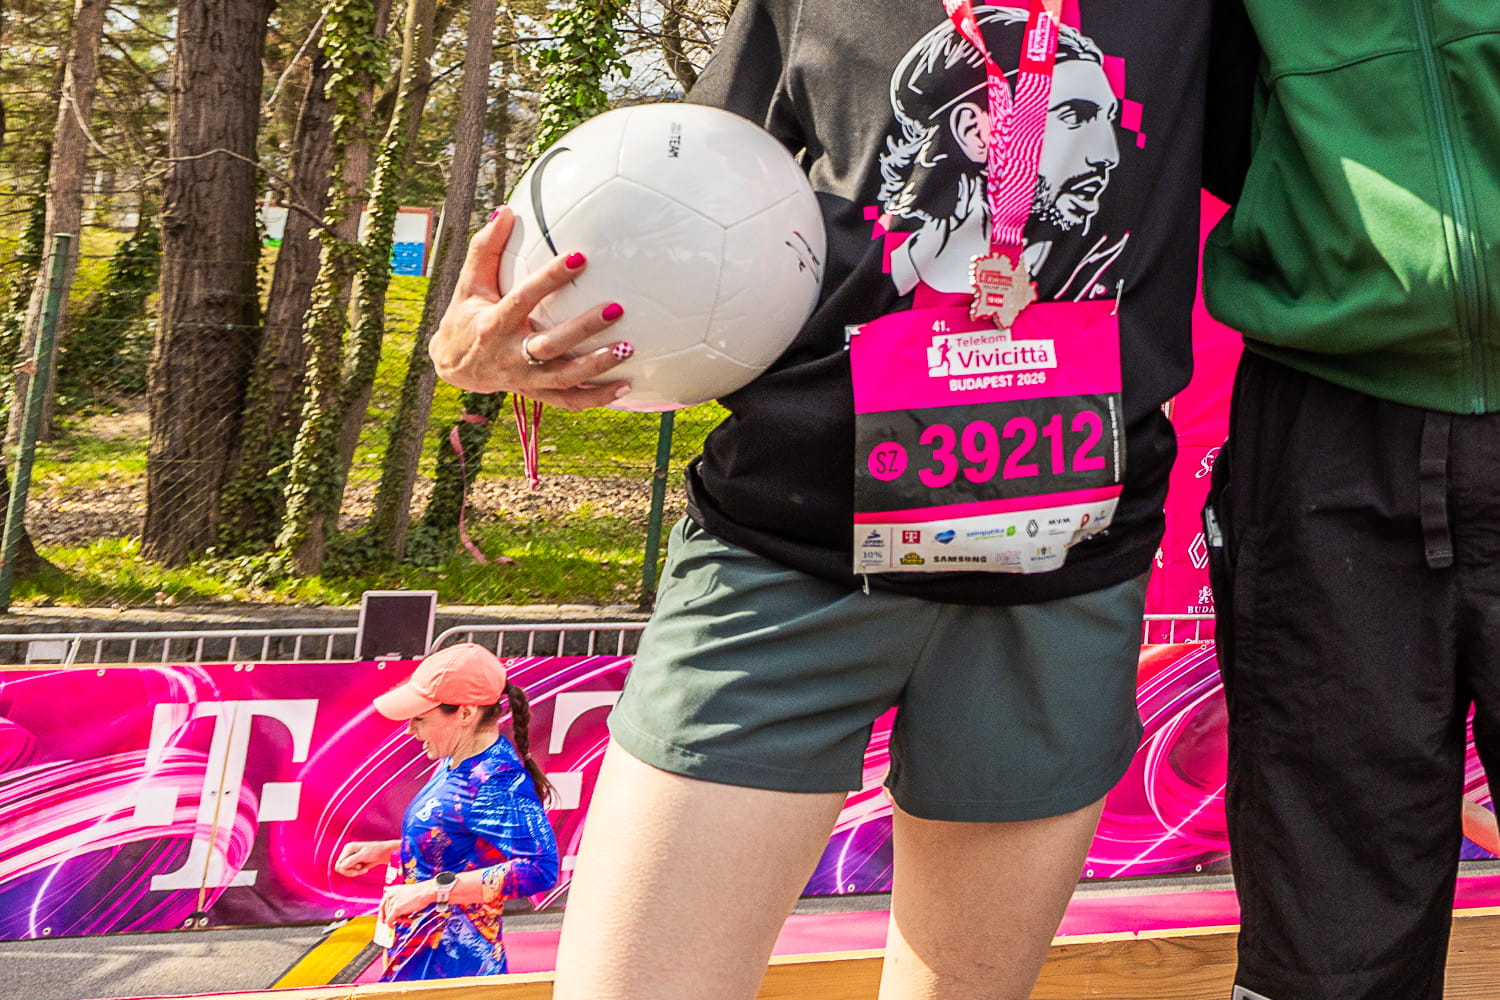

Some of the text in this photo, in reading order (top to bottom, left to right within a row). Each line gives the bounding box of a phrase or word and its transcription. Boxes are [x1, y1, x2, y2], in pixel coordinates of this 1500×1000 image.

[931, 319, 951, 333] 41.
[956, 334, 1008, 348] Telekom
[957, 344, 1049, 369] Vivicittá
[949, 371, 1047, 392] BUDAPEST 2026
[918, 410, 1106, 488] 39212
[876, 450, 899, 474] SZ
[933, 555, 988, 563] SAMSUNG
[1187, 605, 1216, 614] BUDA
[131, 699, 319, 892] T
